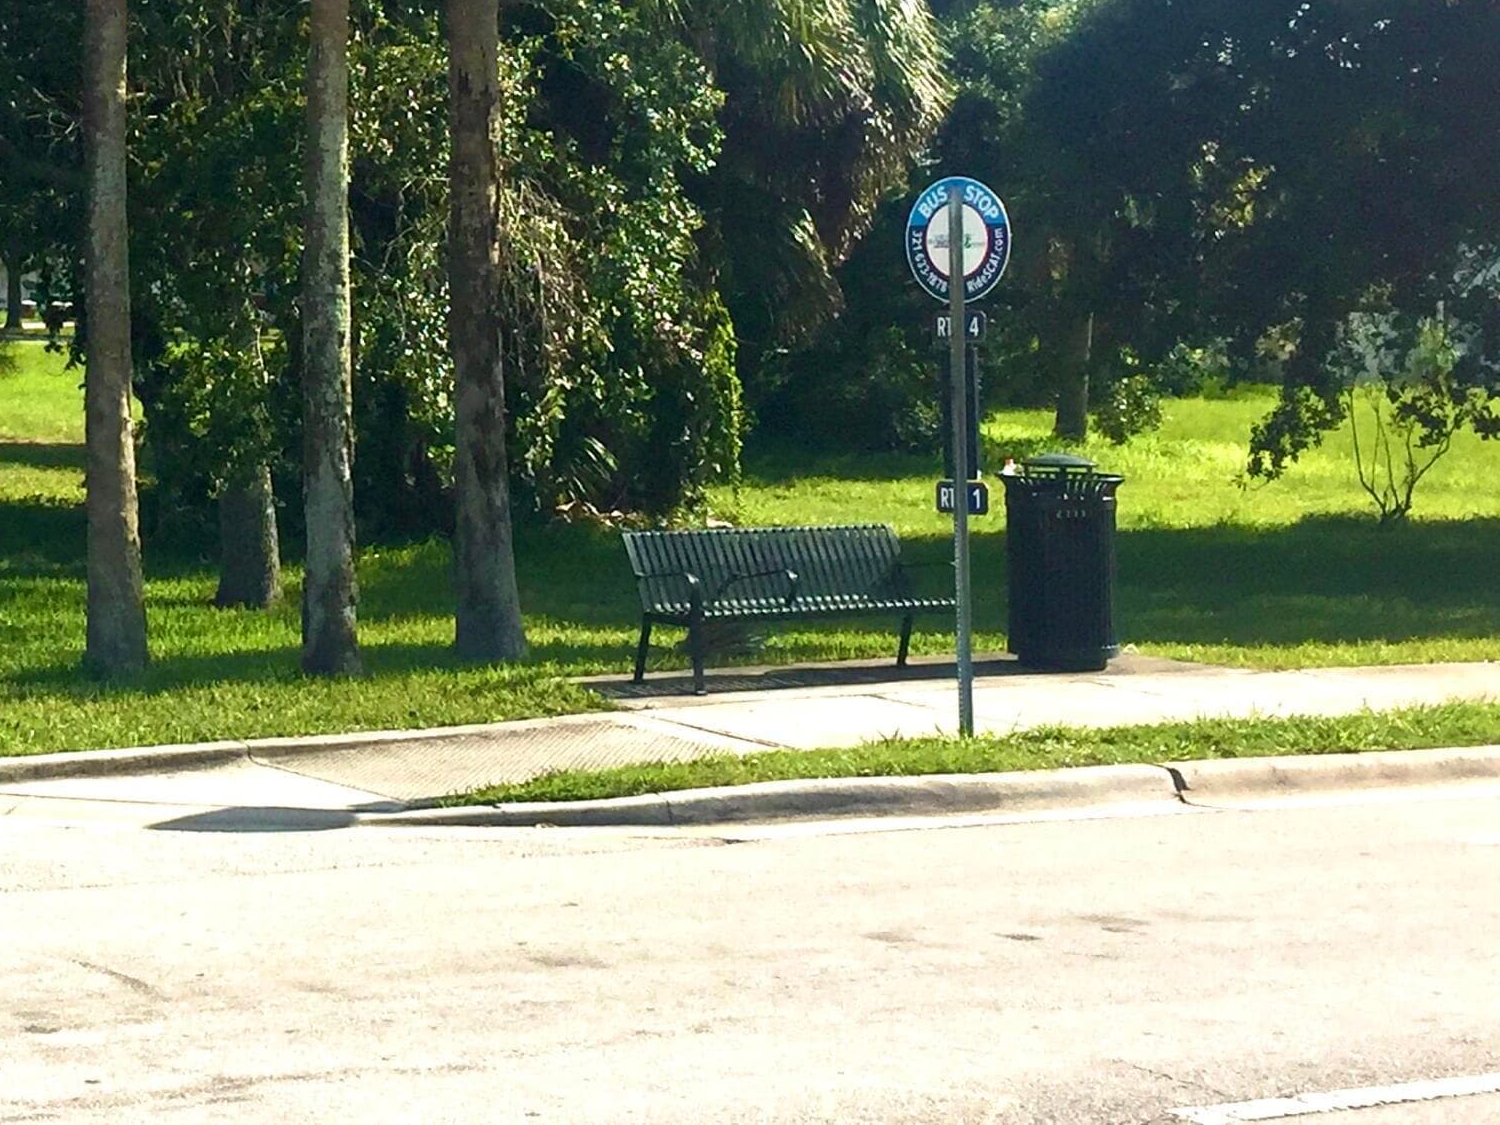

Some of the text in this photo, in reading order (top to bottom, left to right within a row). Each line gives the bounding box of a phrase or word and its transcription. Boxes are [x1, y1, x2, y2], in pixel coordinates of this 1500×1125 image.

[918, 185, 999, 219] BUS STOP
[969, 316, 979, 337] 4
[972, 488, 980, 509] 1
